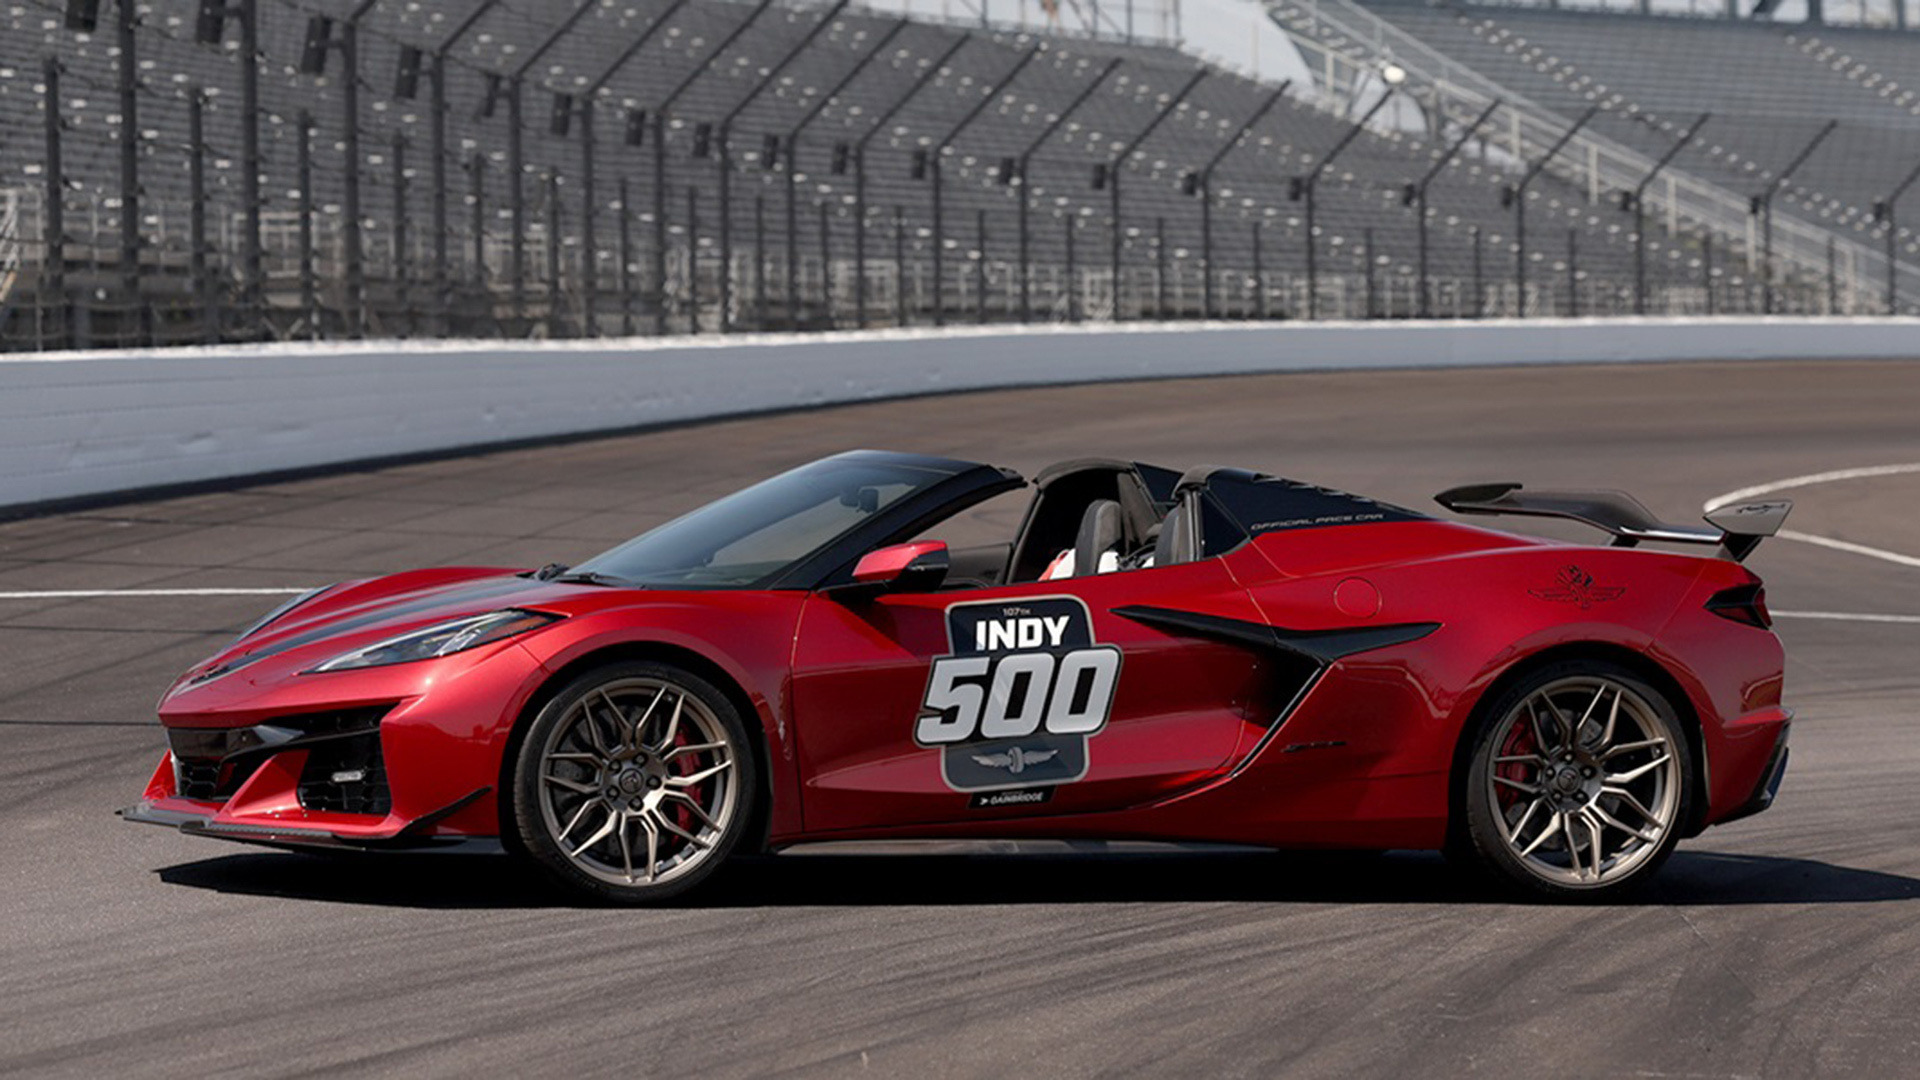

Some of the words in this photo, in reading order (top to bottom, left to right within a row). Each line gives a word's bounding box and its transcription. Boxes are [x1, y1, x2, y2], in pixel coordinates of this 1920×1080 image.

[1251, 519, 1312, 530] OFFICIAL
[1315, 515, 1352, 523] PACE
[1355, 513, 1384, 521] CAR
[1003, 608, 1031, 616] 107TH
[976, 616, 1070, 651] INDY
[917, 648, 1120, 743] 500
[990, 792, 1043, 805] GAINBRIDGE
